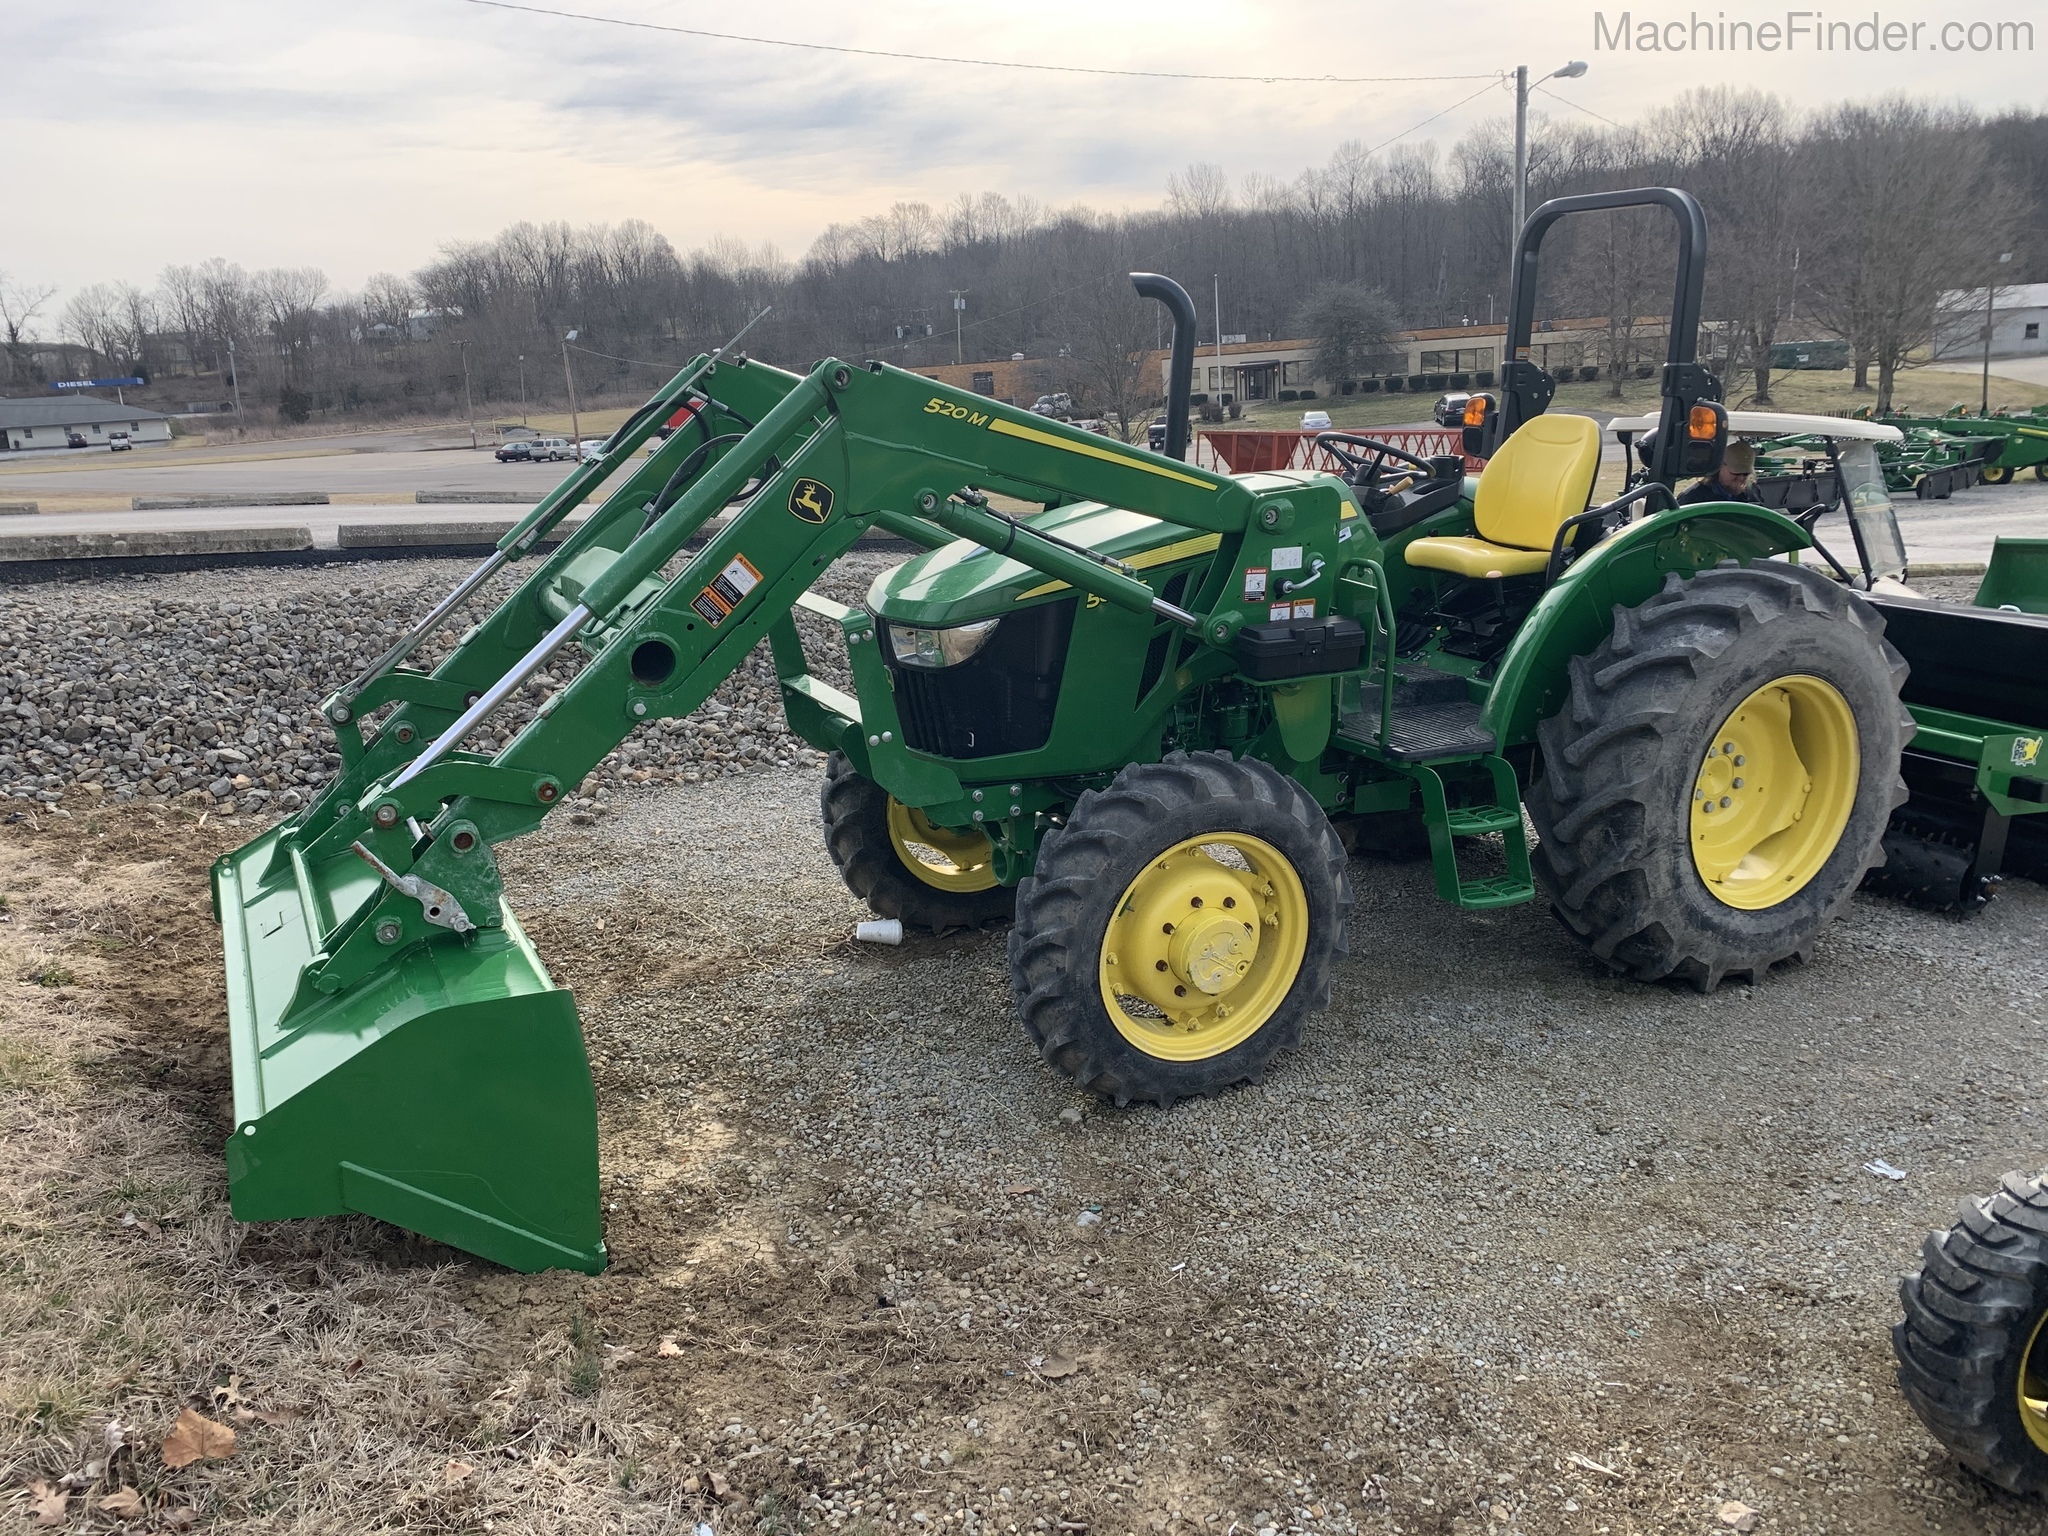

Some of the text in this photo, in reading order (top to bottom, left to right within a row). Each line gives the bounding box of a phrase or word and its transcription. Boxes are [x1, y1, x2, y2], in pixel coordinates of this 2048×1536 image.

[57, 380, 96, 388] DIESEL
[923, 397, 989, 427] 520 M
[742, 560, 760, 578] WARNING
[710, 595, 728, 612] WARNING
